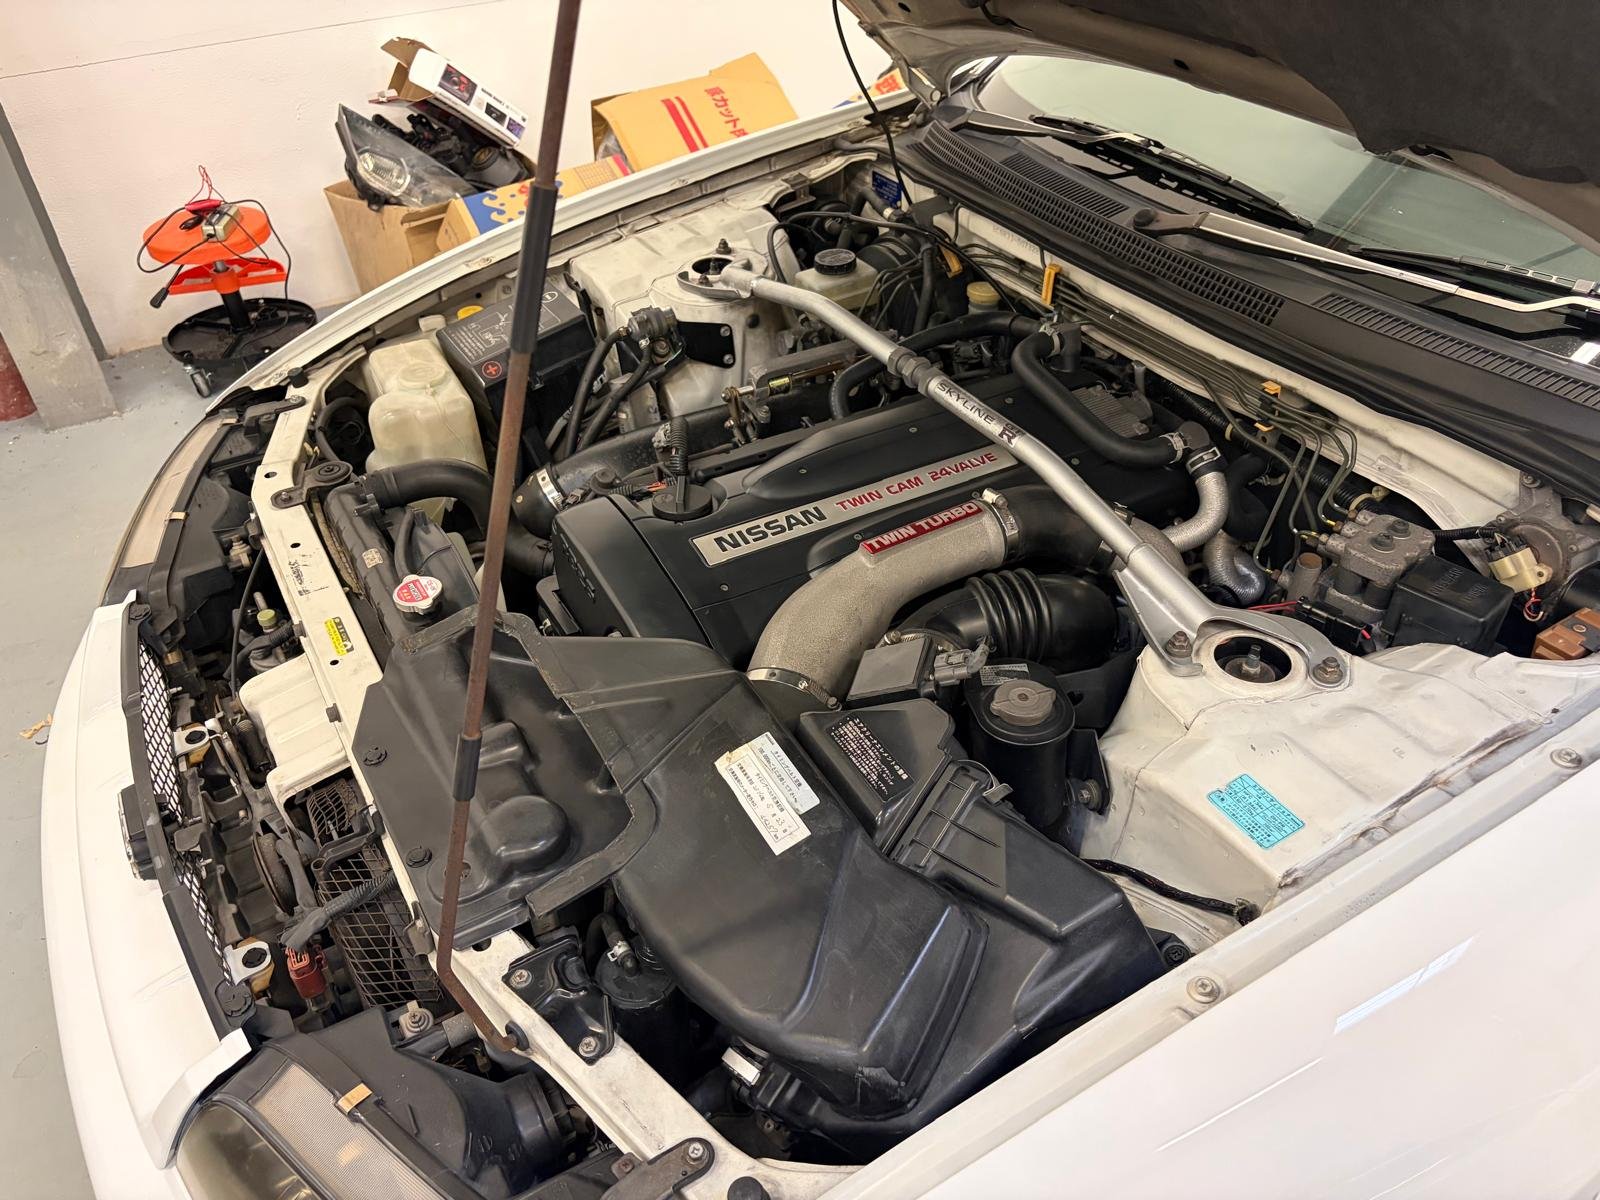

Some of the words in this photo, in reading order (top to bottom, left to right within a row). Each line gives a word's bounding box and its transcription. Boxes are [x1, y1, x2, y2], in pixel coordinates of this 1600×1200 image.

[937, 381, 995, 424] SKYLINE
[713, 506, 827, 552] NISSAN
[835, 490, 883, 512] TWIN
[886, 476, 924, 496] CAM
[928, 452, 997, 482] 24VALVE
[865, 527, 917, 550] TWIN
[918, 502, 979, 532] TURBO
